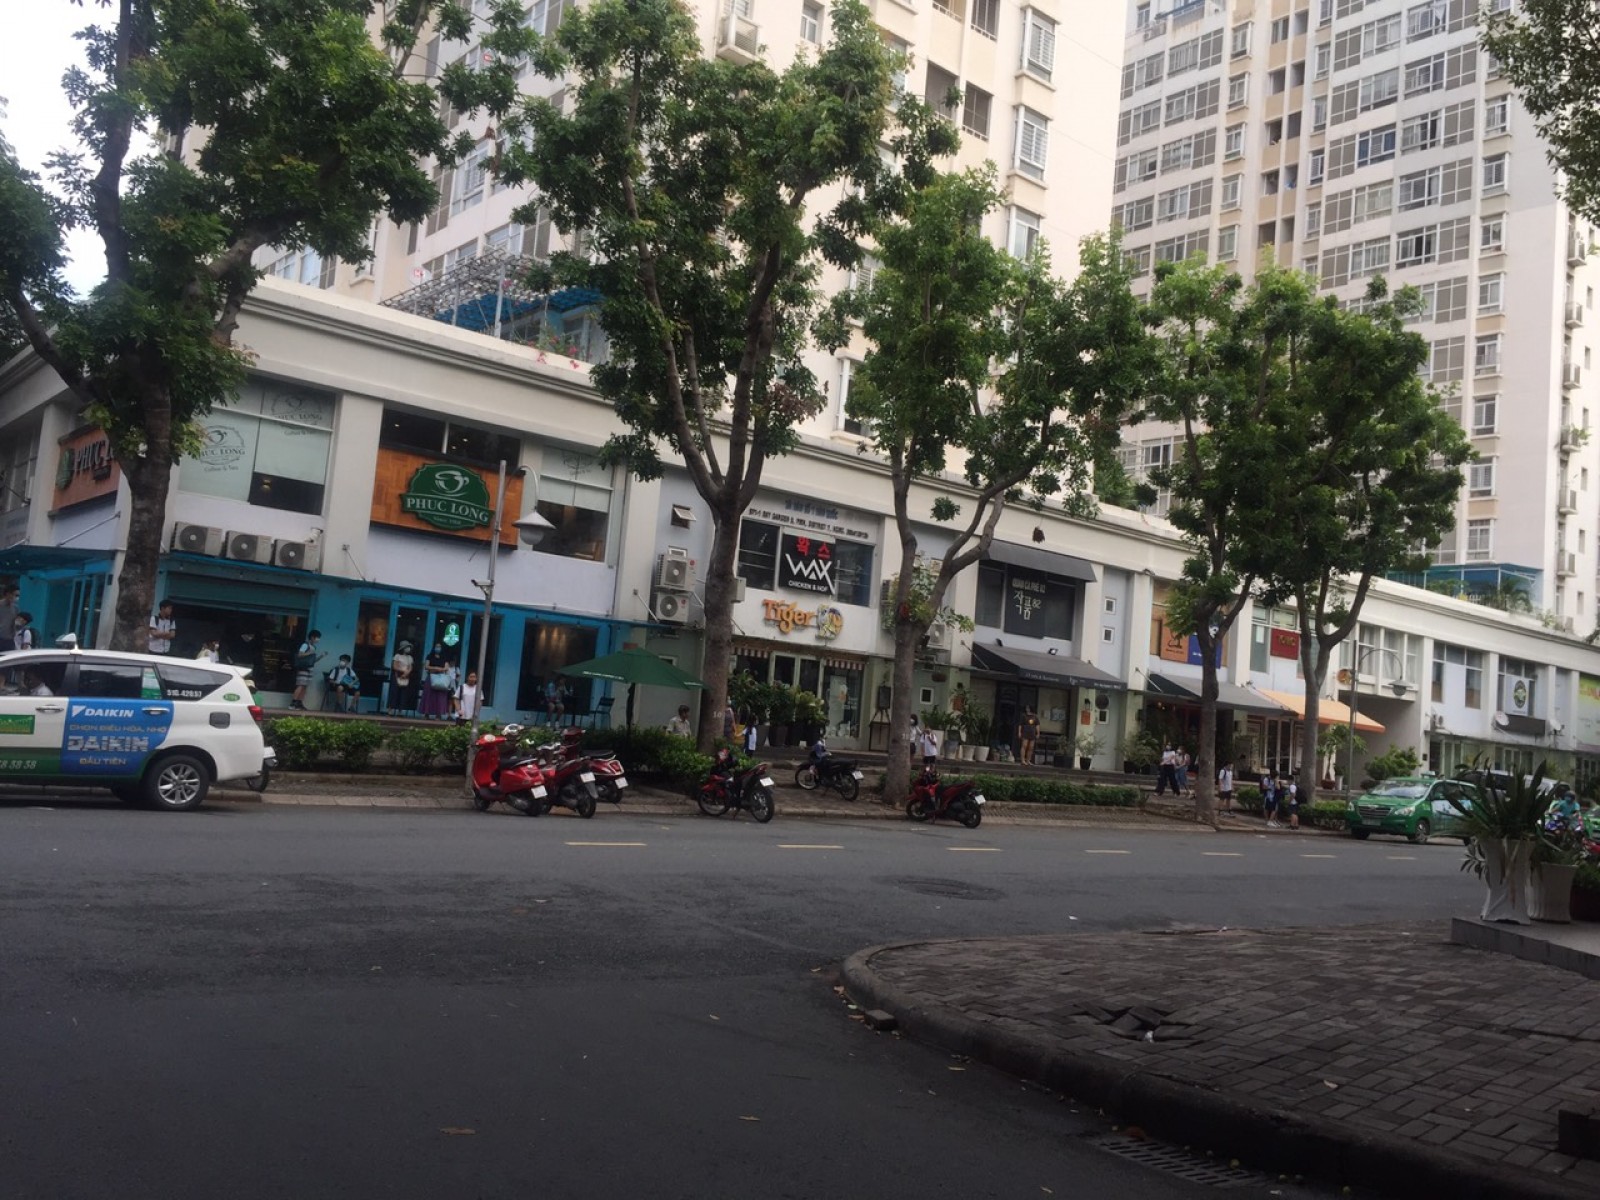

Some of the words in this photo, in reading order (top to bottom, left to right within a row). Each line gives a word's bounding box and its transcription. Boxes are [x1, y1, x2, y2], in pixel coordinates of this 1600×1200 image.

[406, 497, 447, 513] PHUC
[450, 502, 490, 523] LONG
[785, 553, 836, 595] WAX
[788, 580, 811, 591] CHICKEN
[762, 599, 816, 635] Tiger
[84, 707, 135, 718] DAIKIN
[67, 735, 150, 753] DAIKIN
